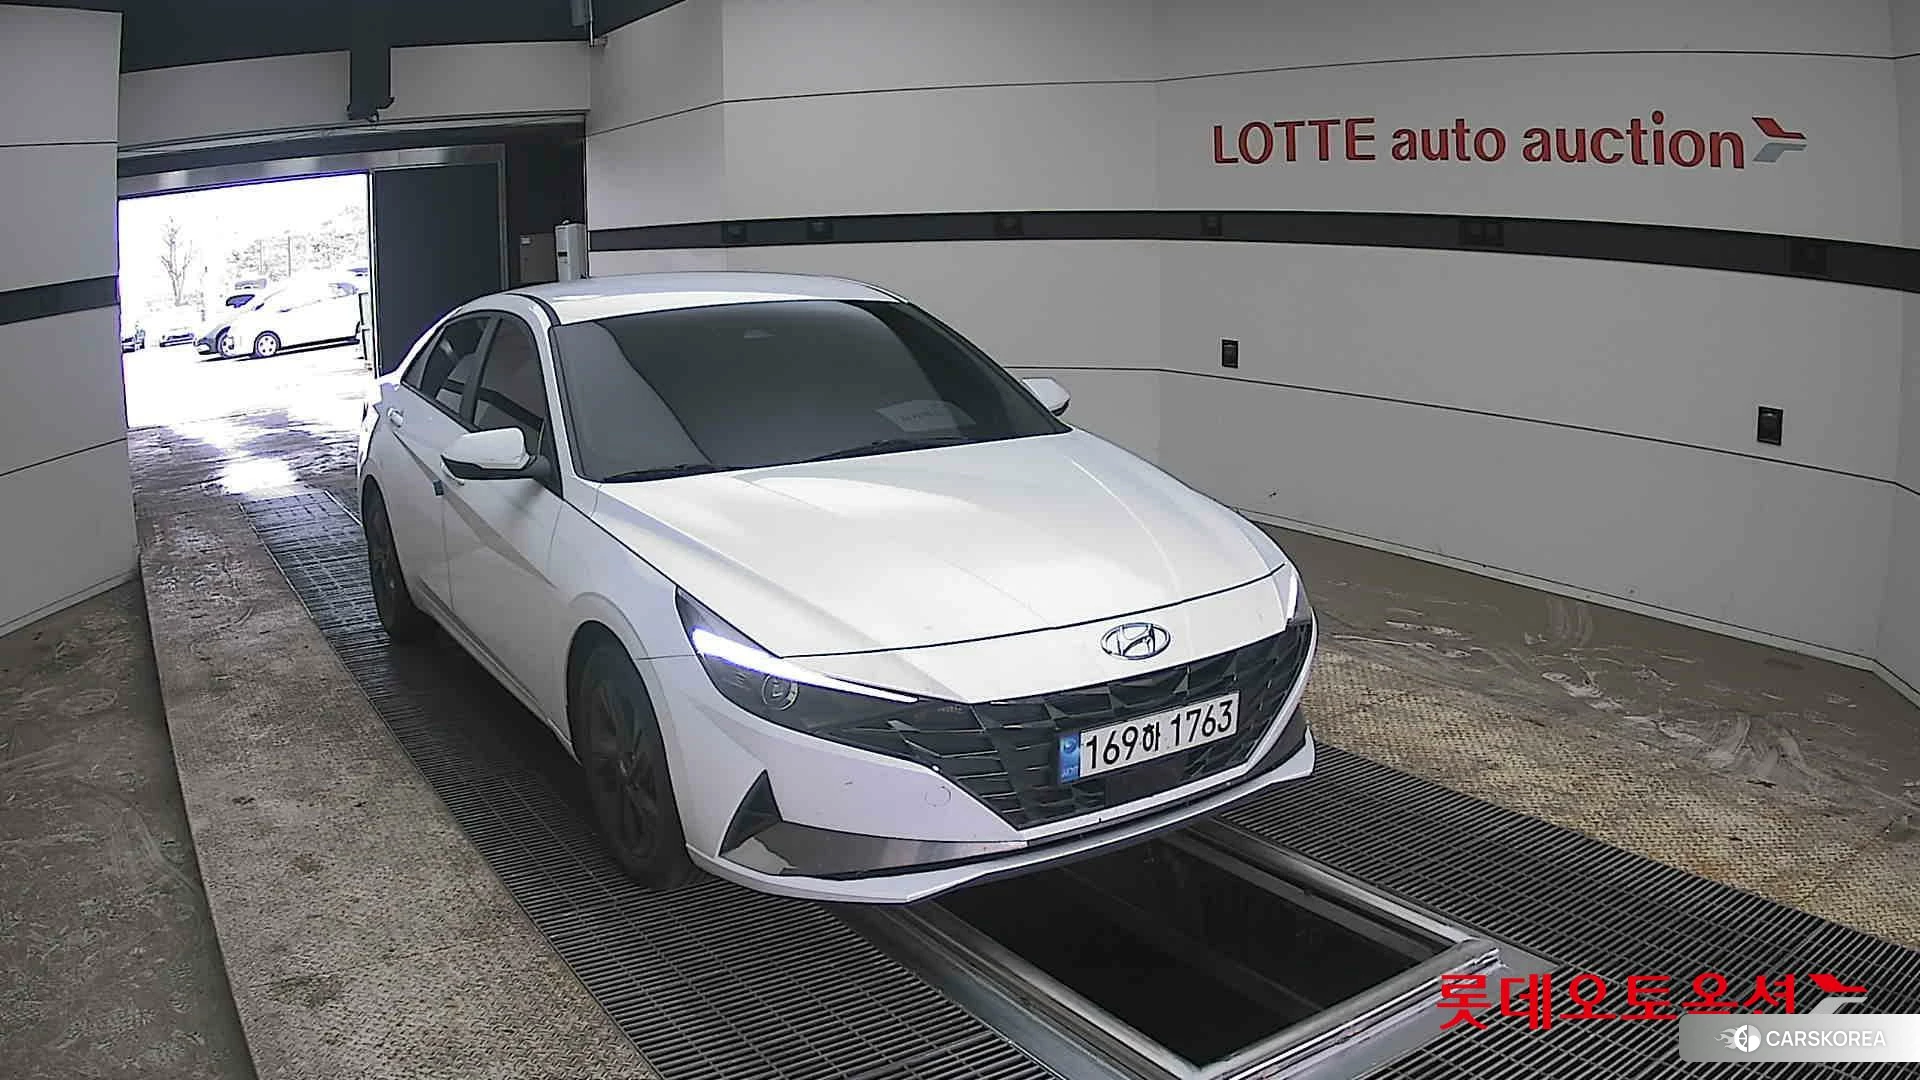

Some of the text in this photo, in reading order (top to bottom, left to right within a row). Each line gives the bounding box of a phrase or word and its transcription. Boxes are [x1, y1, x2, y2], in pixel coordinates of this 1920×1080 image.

[1213, 110, 1746, 170] LOTTE auto auction
[1085, 699, 1233, 770] 169하 1763
